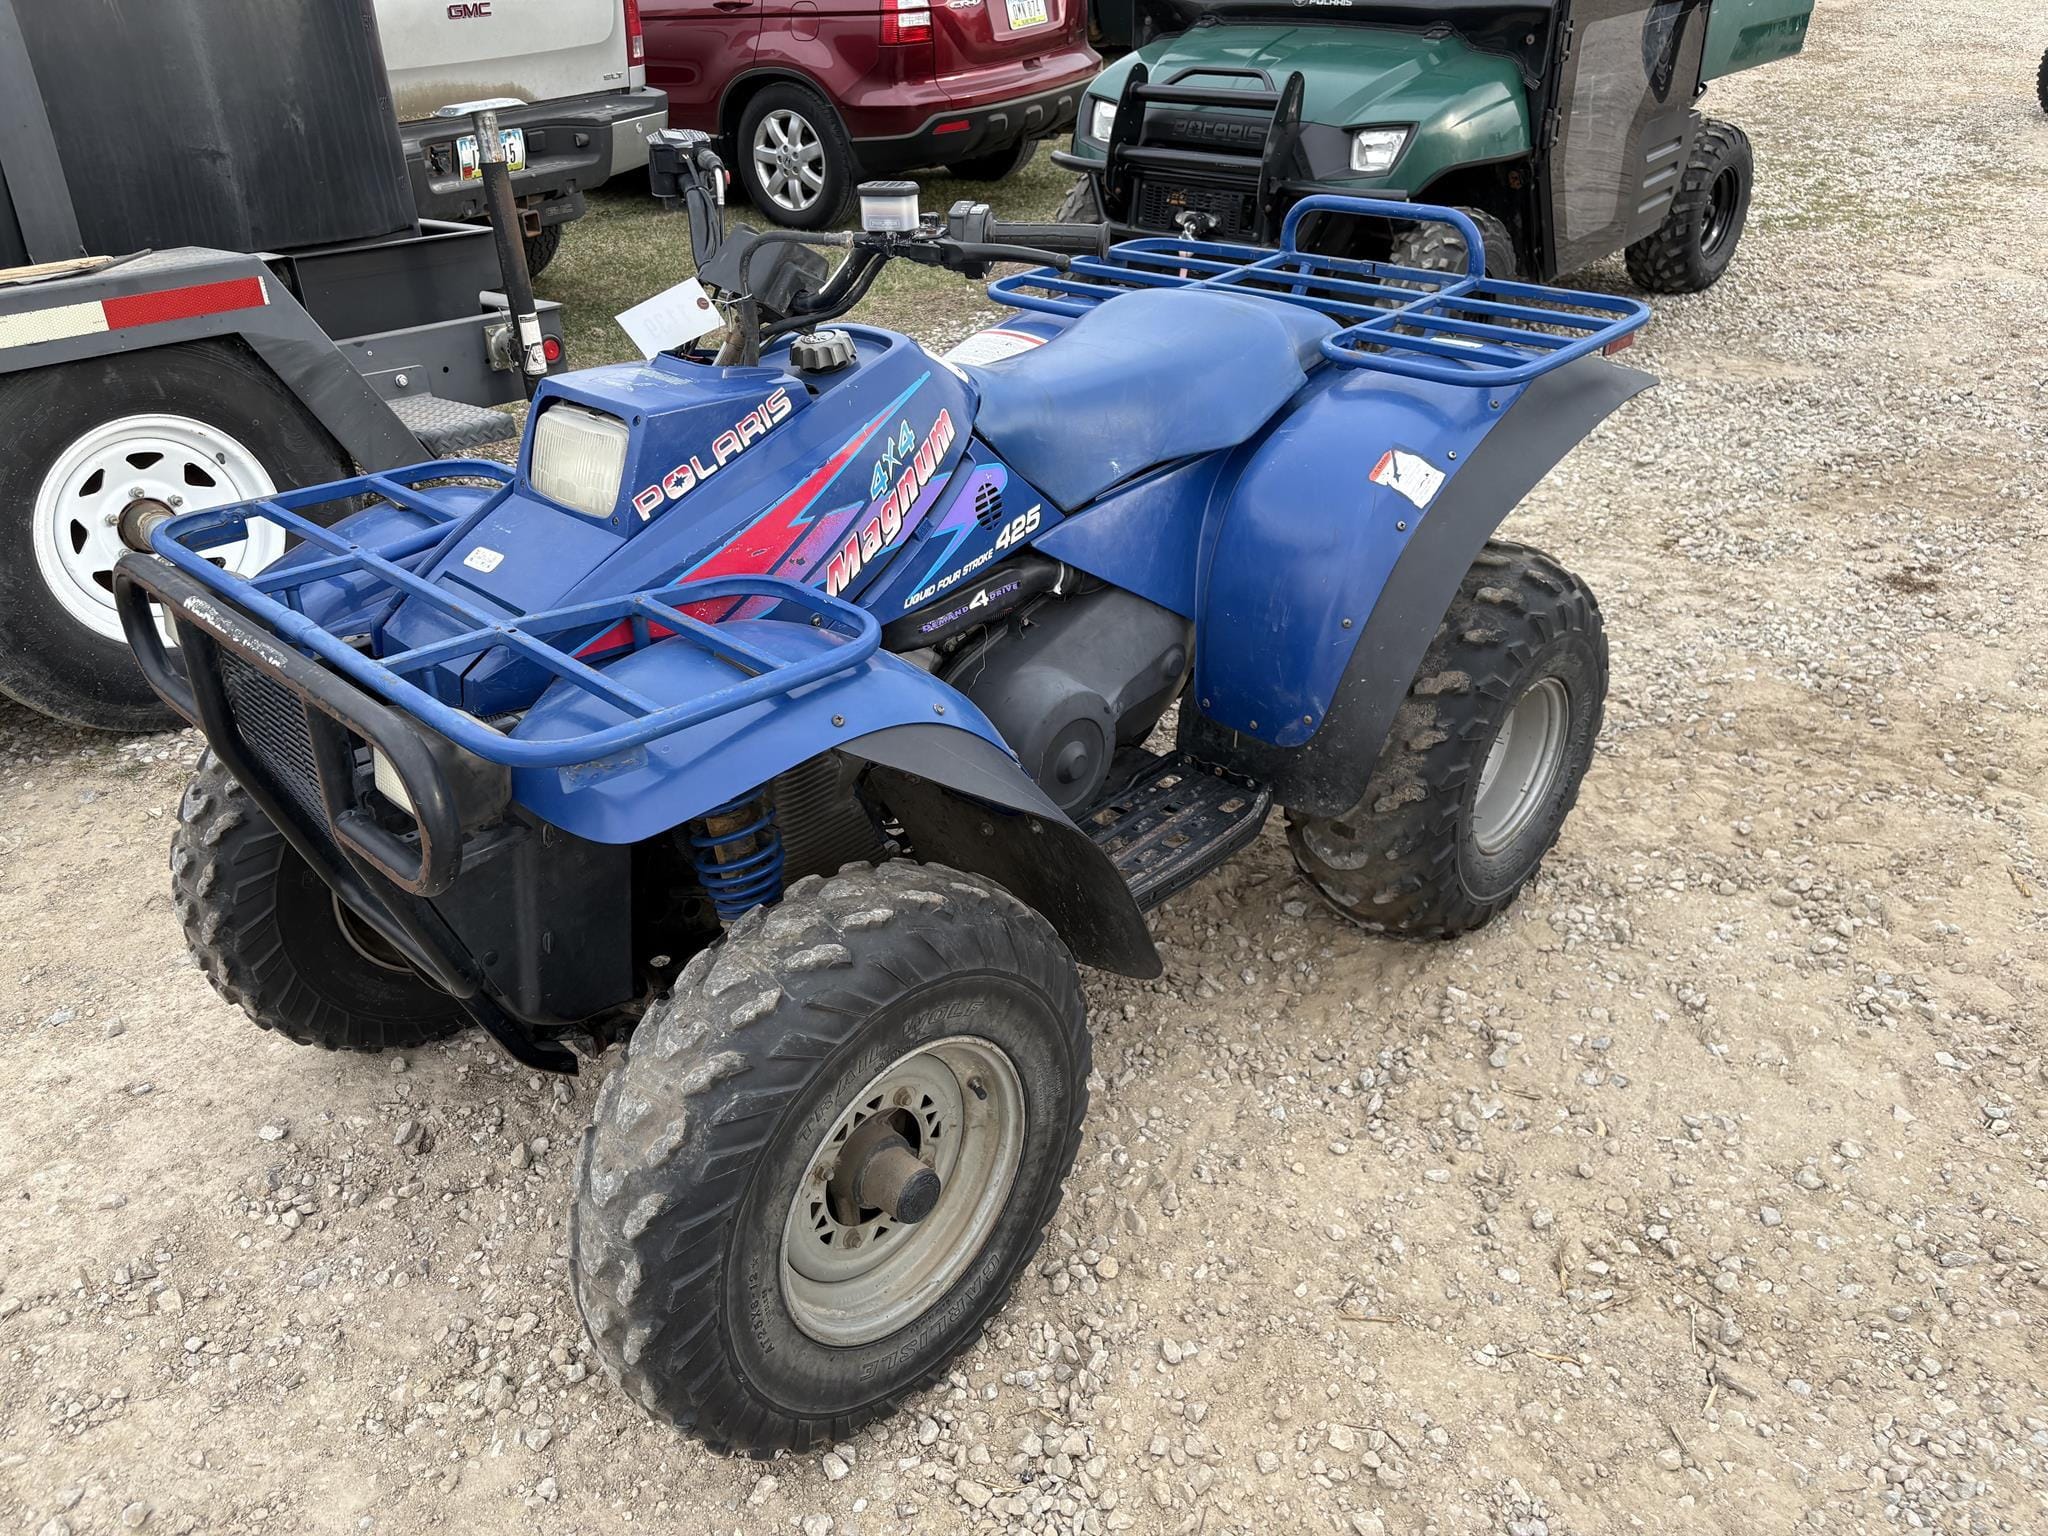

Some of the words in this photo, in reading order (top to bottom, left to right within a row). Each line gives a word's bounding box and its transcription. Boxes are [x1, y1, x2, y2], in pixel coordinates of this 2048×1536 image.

[448, 2, 492, 20] GMC
[603, 71, 623, 81] SLT
[631, 386, 792, 522] POLARIS
[826, 407, 956, 597] Magnum
[903, 584, 935, 610] LIQUID
[937, 569, 962, 592] FOUR
[961, 548, 994, 577] STROKE
[995, 503, 1042, 552] 425
[921, 606, 969, 633] DEMAND
[968, 588, 991, 610] 4
[989, 582, 1019, 602] DRIVE
[799, 1046, 889, 1142] TRAIL
[902, 999, 985, 1038] WOLF
[859, 1253, 1001, 1383] CARLISLE
